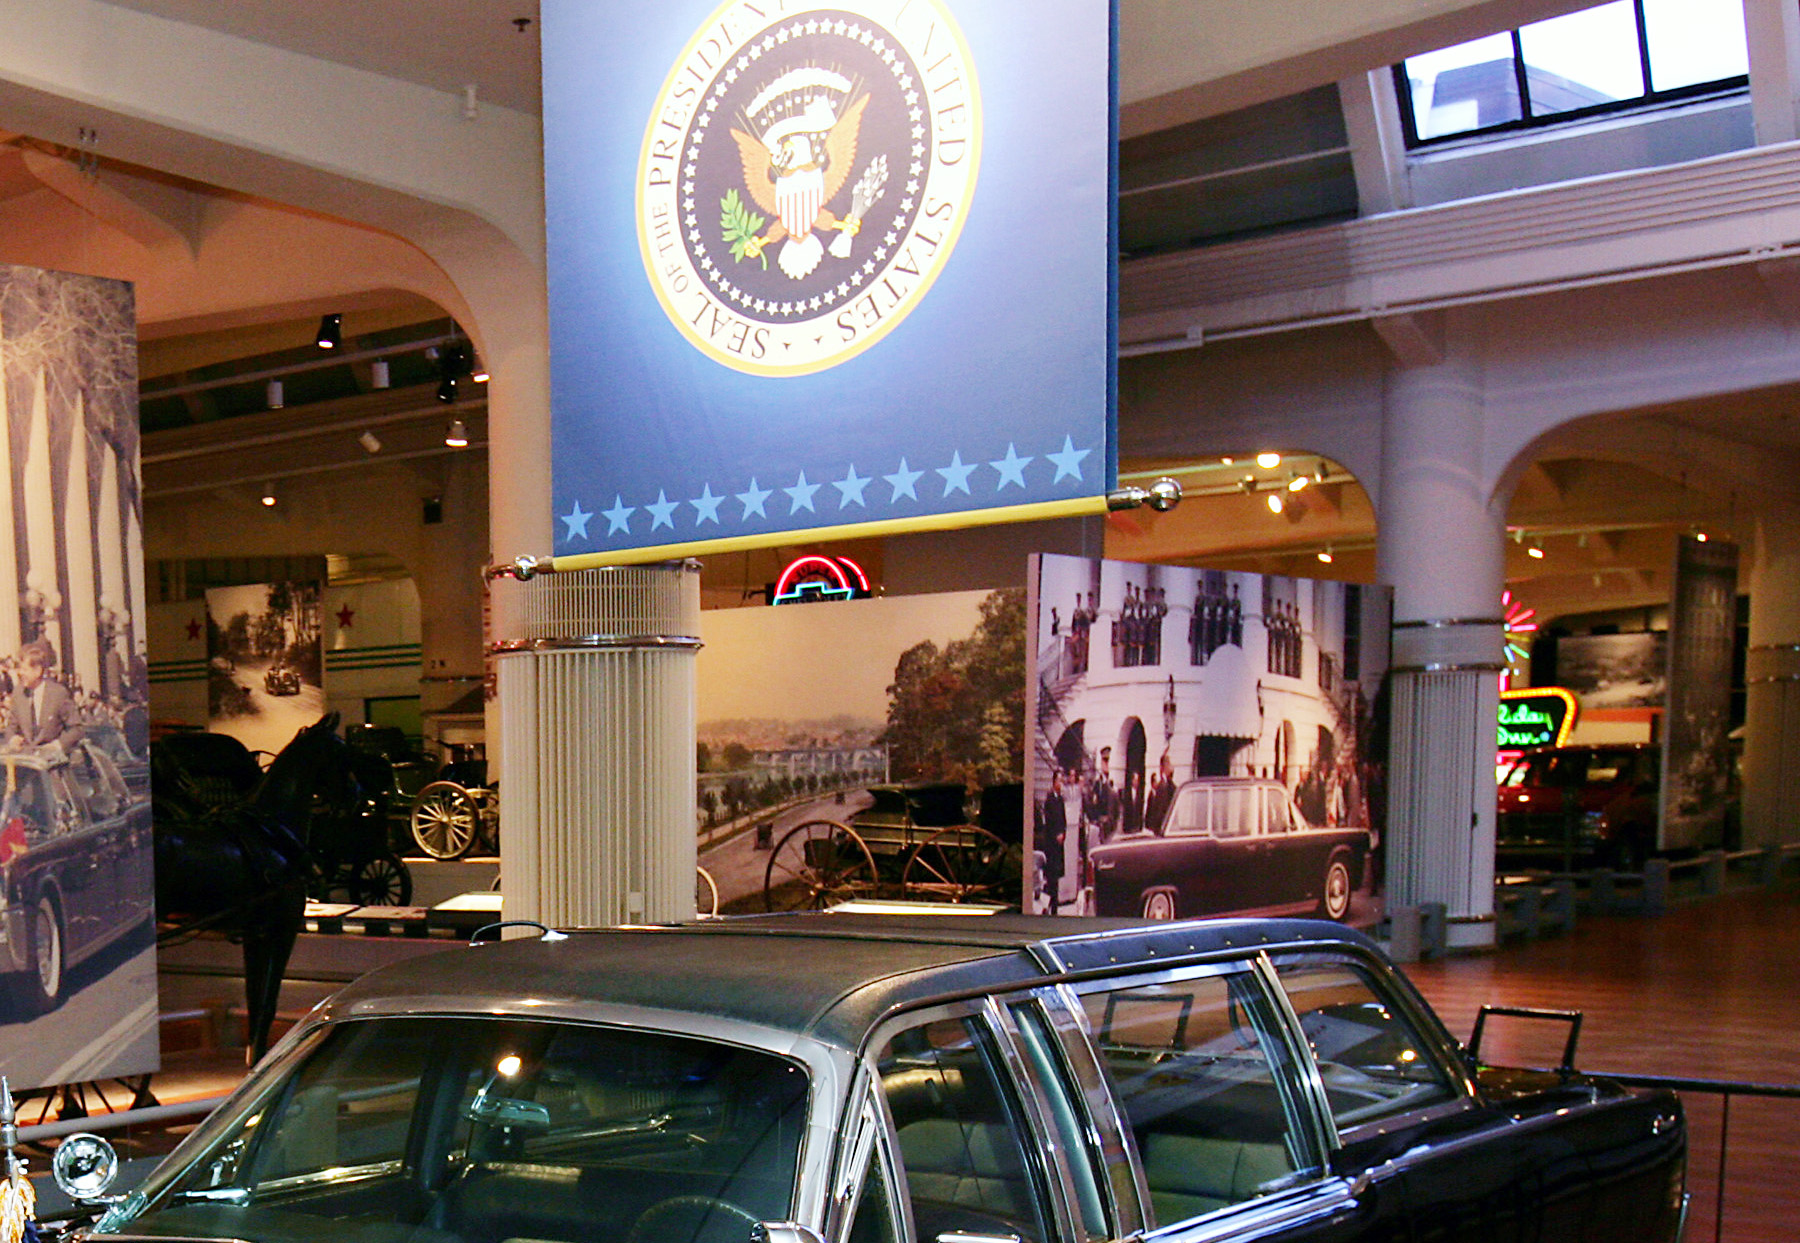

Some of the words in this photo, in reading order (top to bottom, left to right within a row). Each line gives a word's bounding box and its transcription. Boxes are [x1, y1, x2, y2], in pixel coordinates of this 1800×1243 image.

[653, 202, 675, 259] THE
[665, 264, 689, 294] OF
[835, 197, 954, 343] STATES
[691, 291, 771, 359] SEAL
